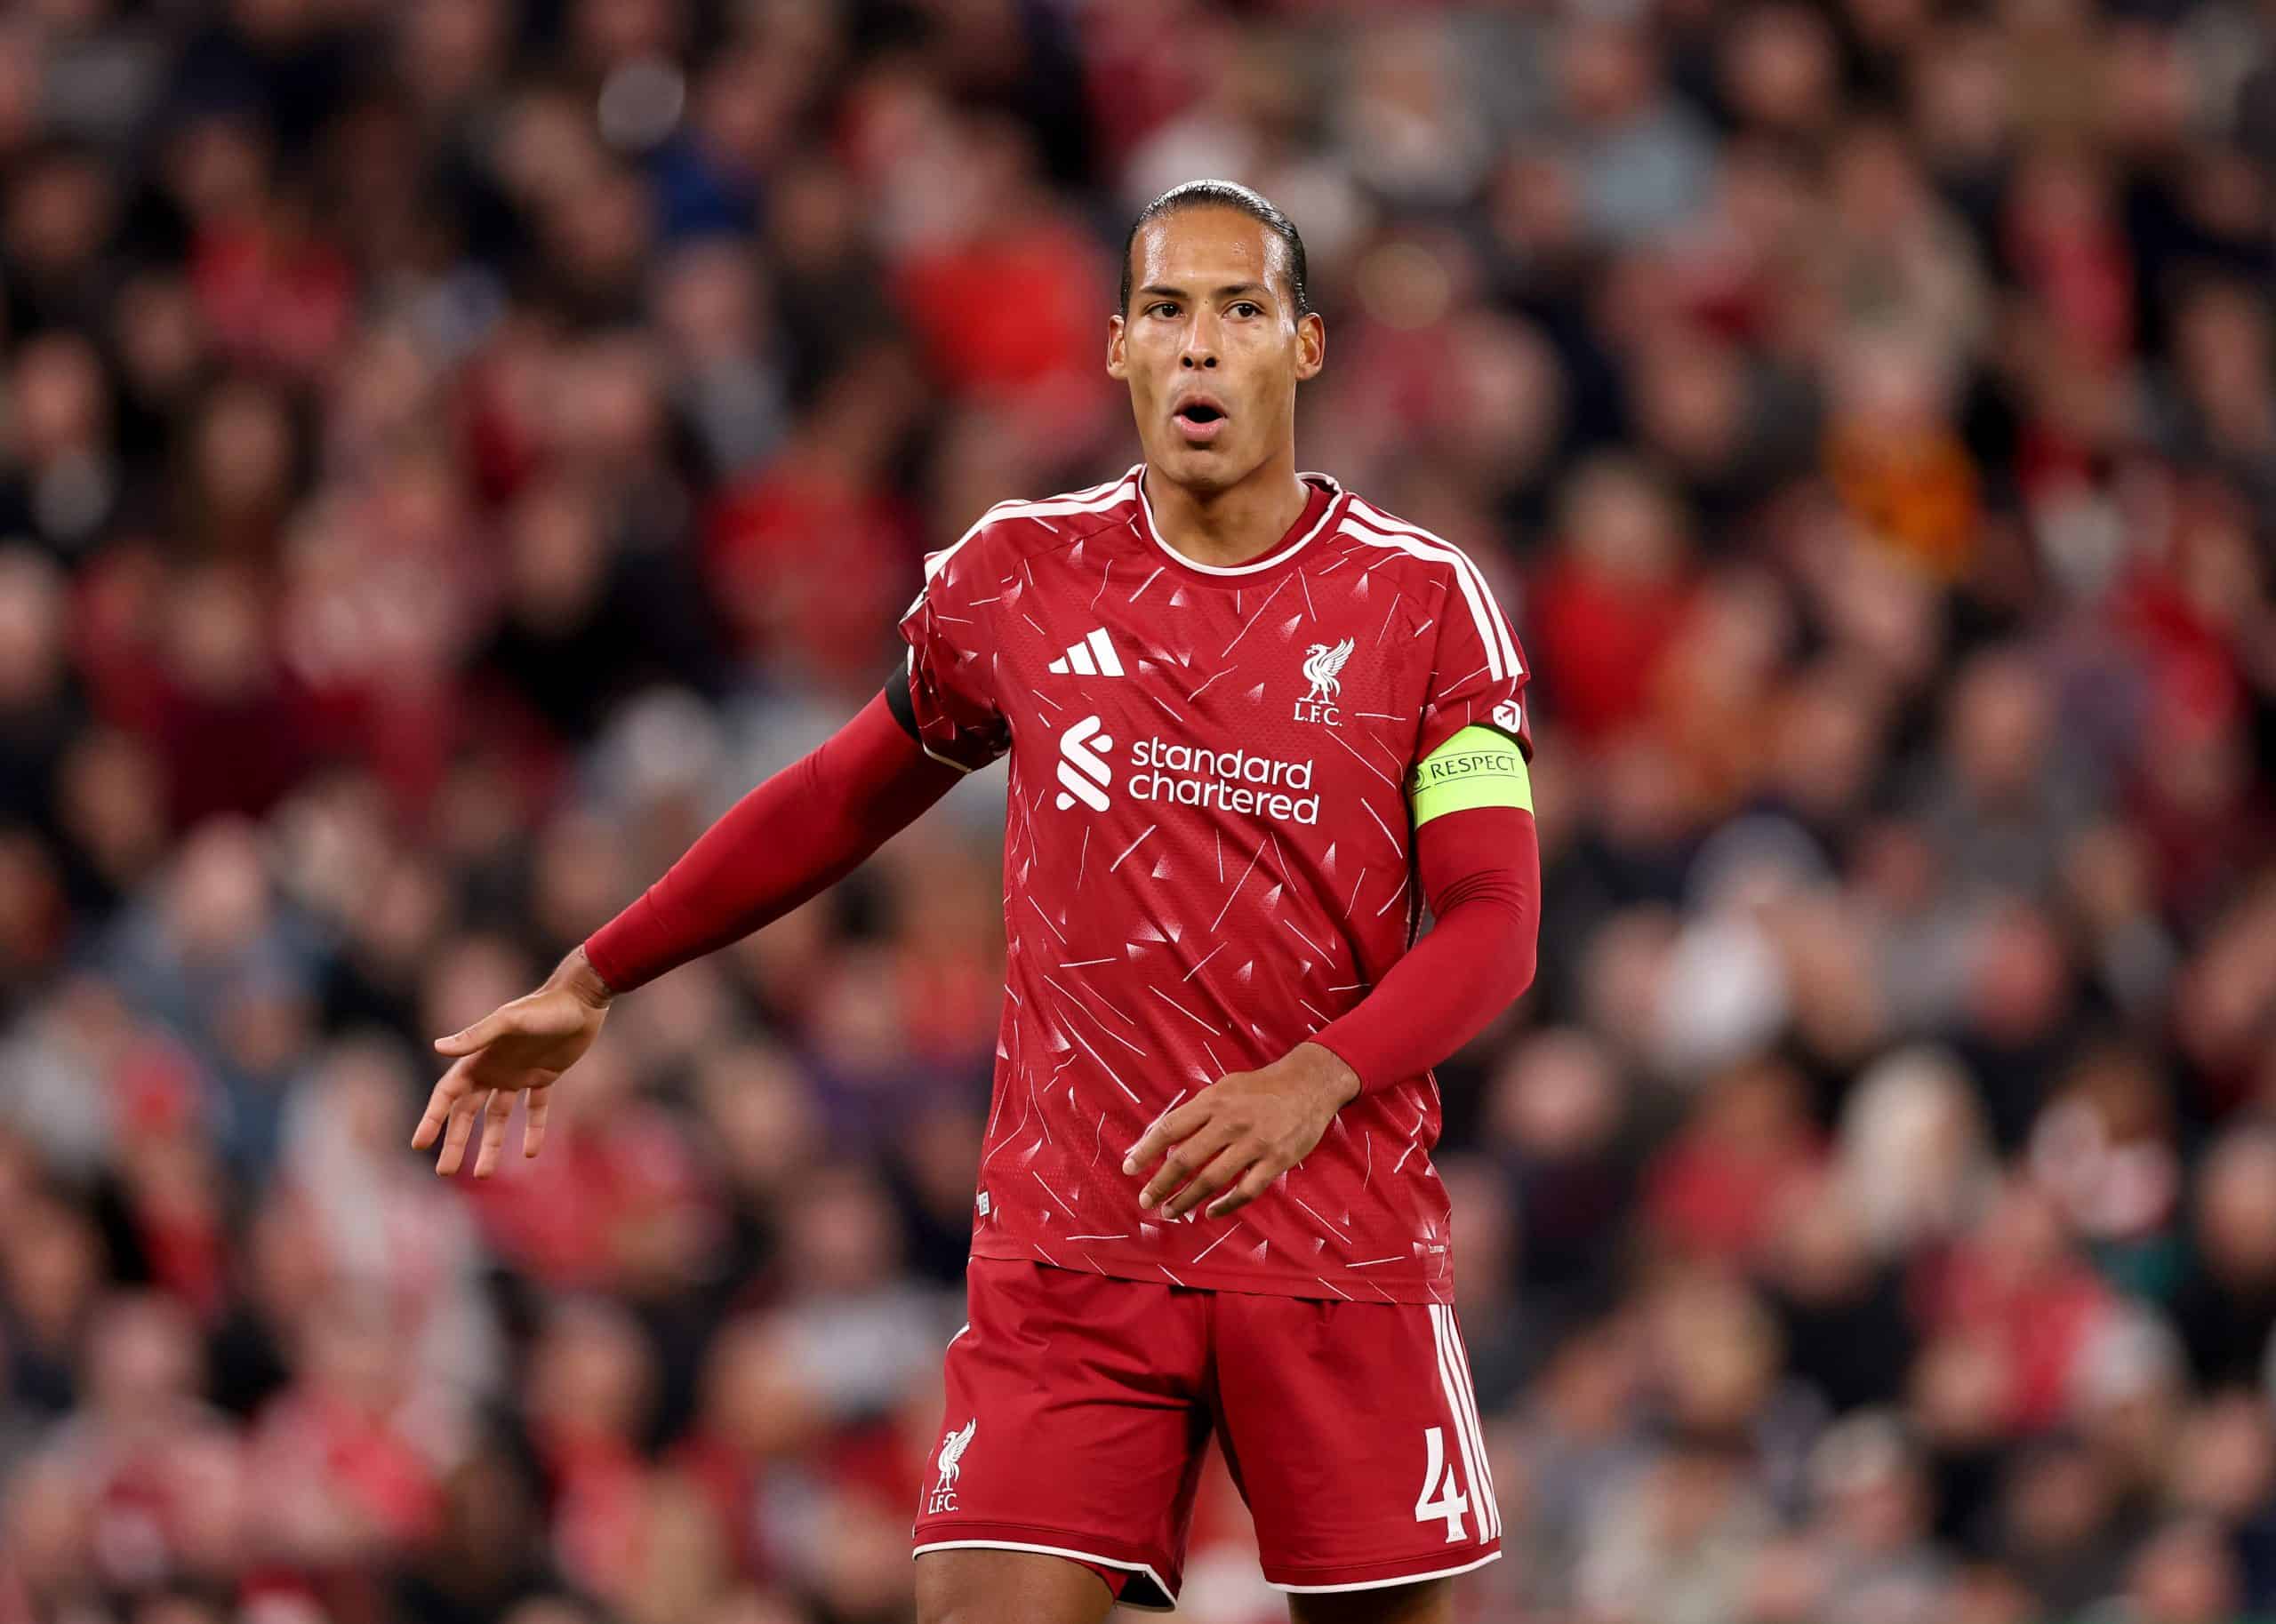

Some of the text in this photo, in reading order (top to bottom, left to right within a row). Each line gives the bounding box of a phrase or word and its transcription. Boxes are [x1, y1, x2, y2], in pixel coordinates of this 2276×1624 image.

[1294, 702, 1343, 726] L.F.C.
[1131, 736, 1313, 790] standard
[1430, 755, 1516, 780] RESPECT
[1128, 770, 1319, 825] chartered
[1414, 1427, 1469, 1543] 4
